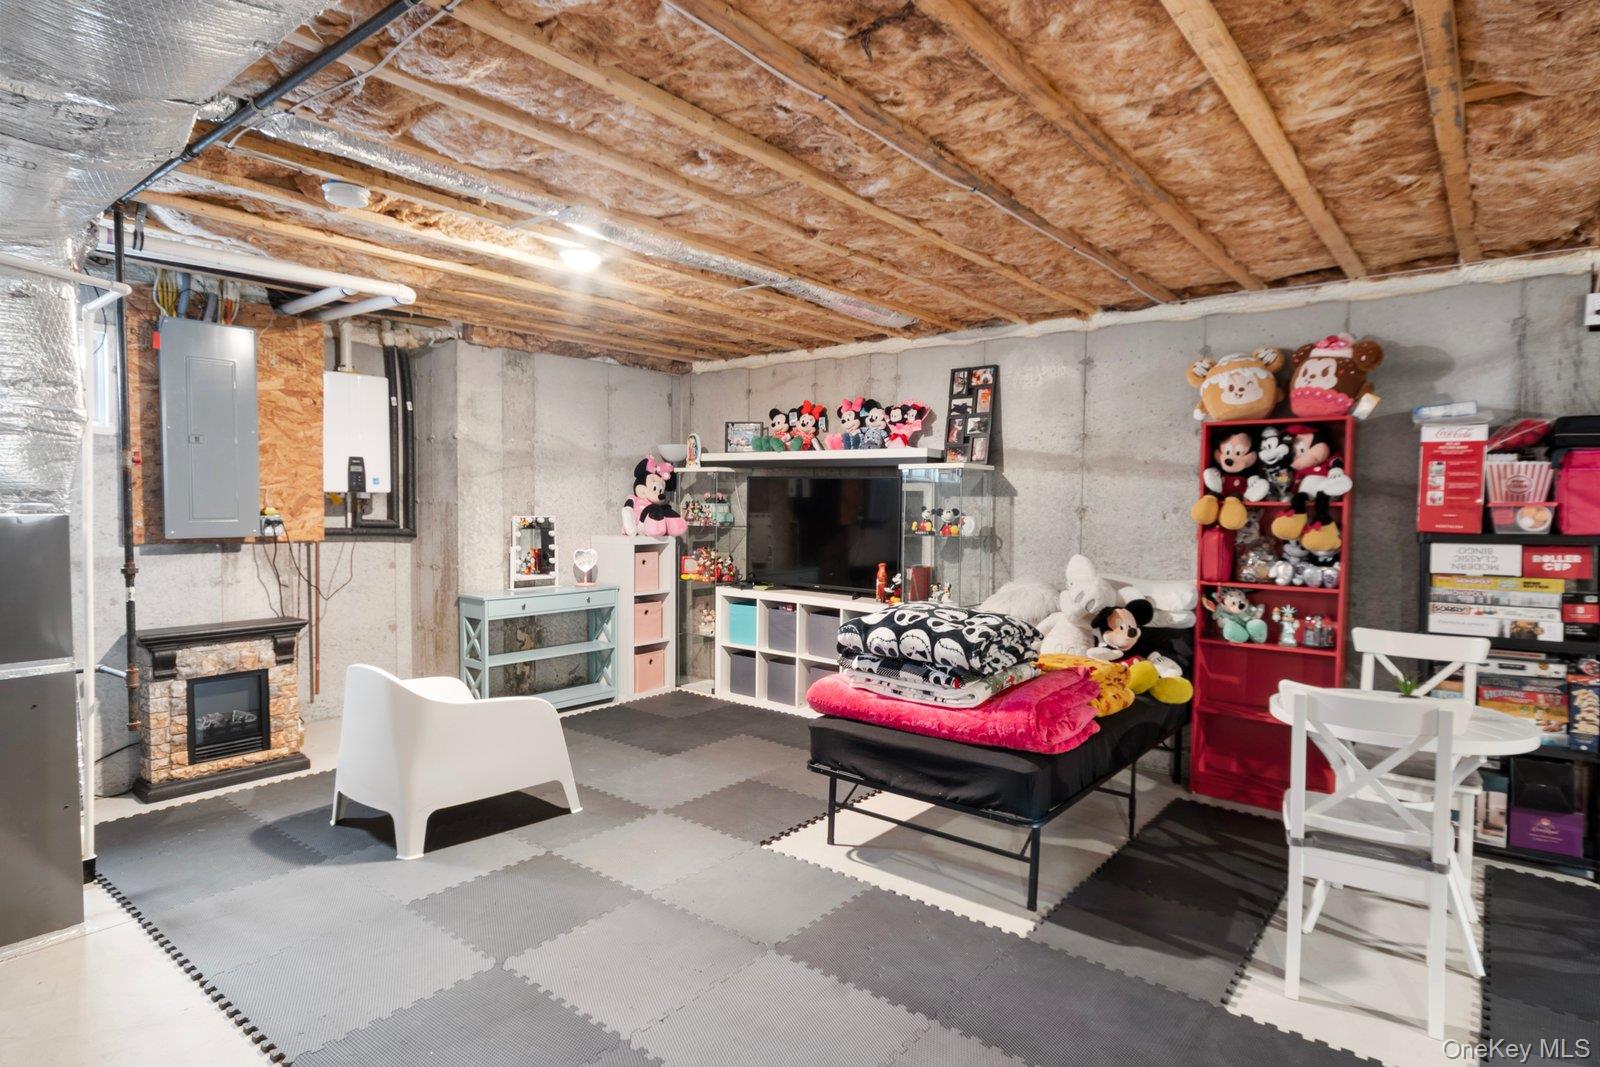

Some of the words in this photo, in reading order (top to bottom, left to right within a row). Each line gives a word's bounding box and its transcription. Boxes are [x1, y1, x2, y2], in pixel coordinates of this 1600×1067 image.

[1458, 546, 1494, 555] BINGO
[1454, 554, 1498, 563] CLASSIC
[1452, 562, 1499, 570] MODERN
